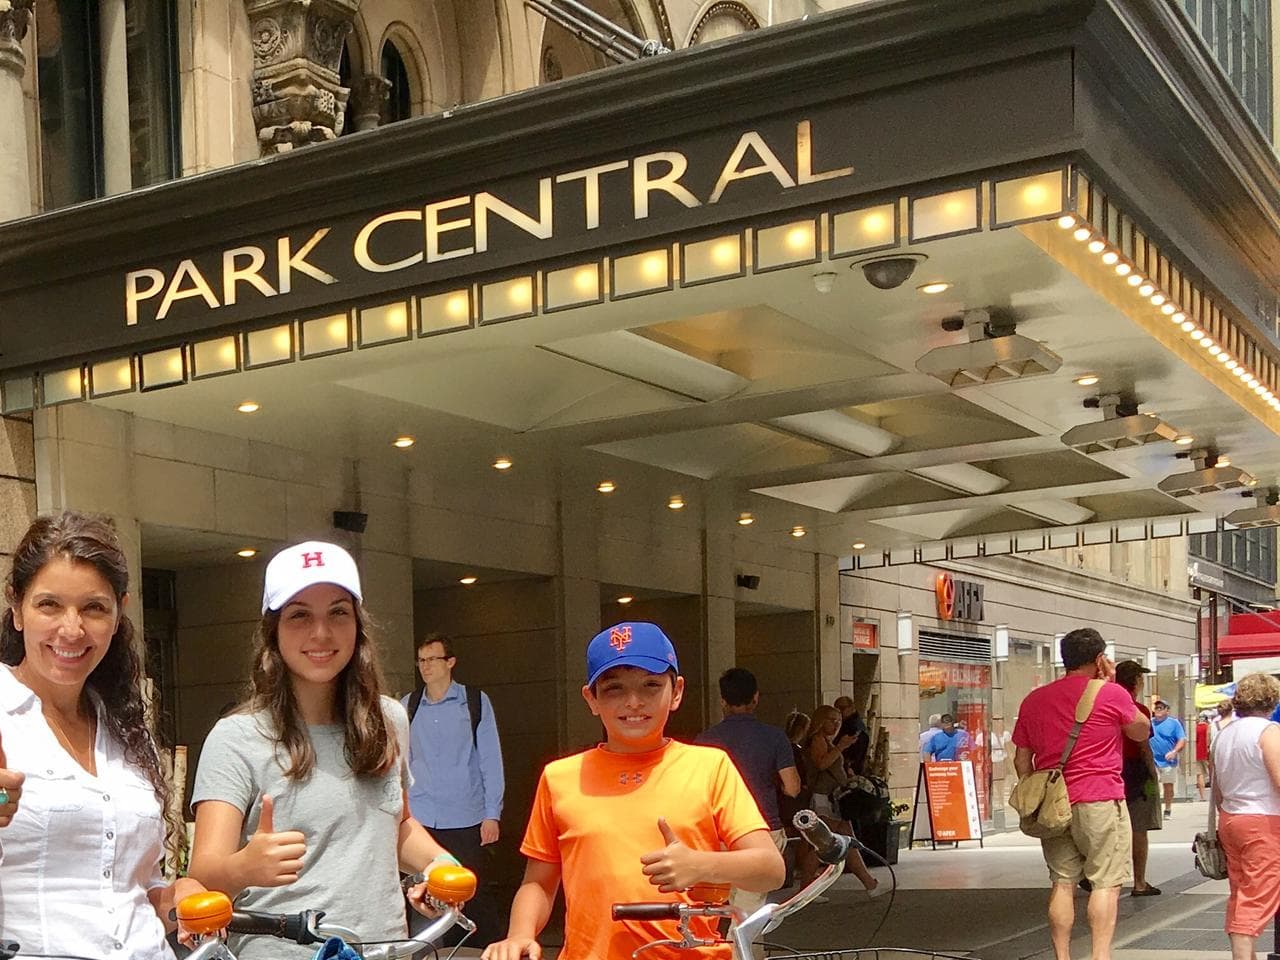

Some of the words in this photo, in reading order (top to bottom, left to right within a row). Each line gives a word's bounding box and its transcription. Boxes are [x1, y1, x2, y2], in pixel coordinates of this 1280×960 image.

[125, 227, 339, 326] PARK
[354, 119, 855, 274] CENTRAL
[301, 551, 325, 569] H
